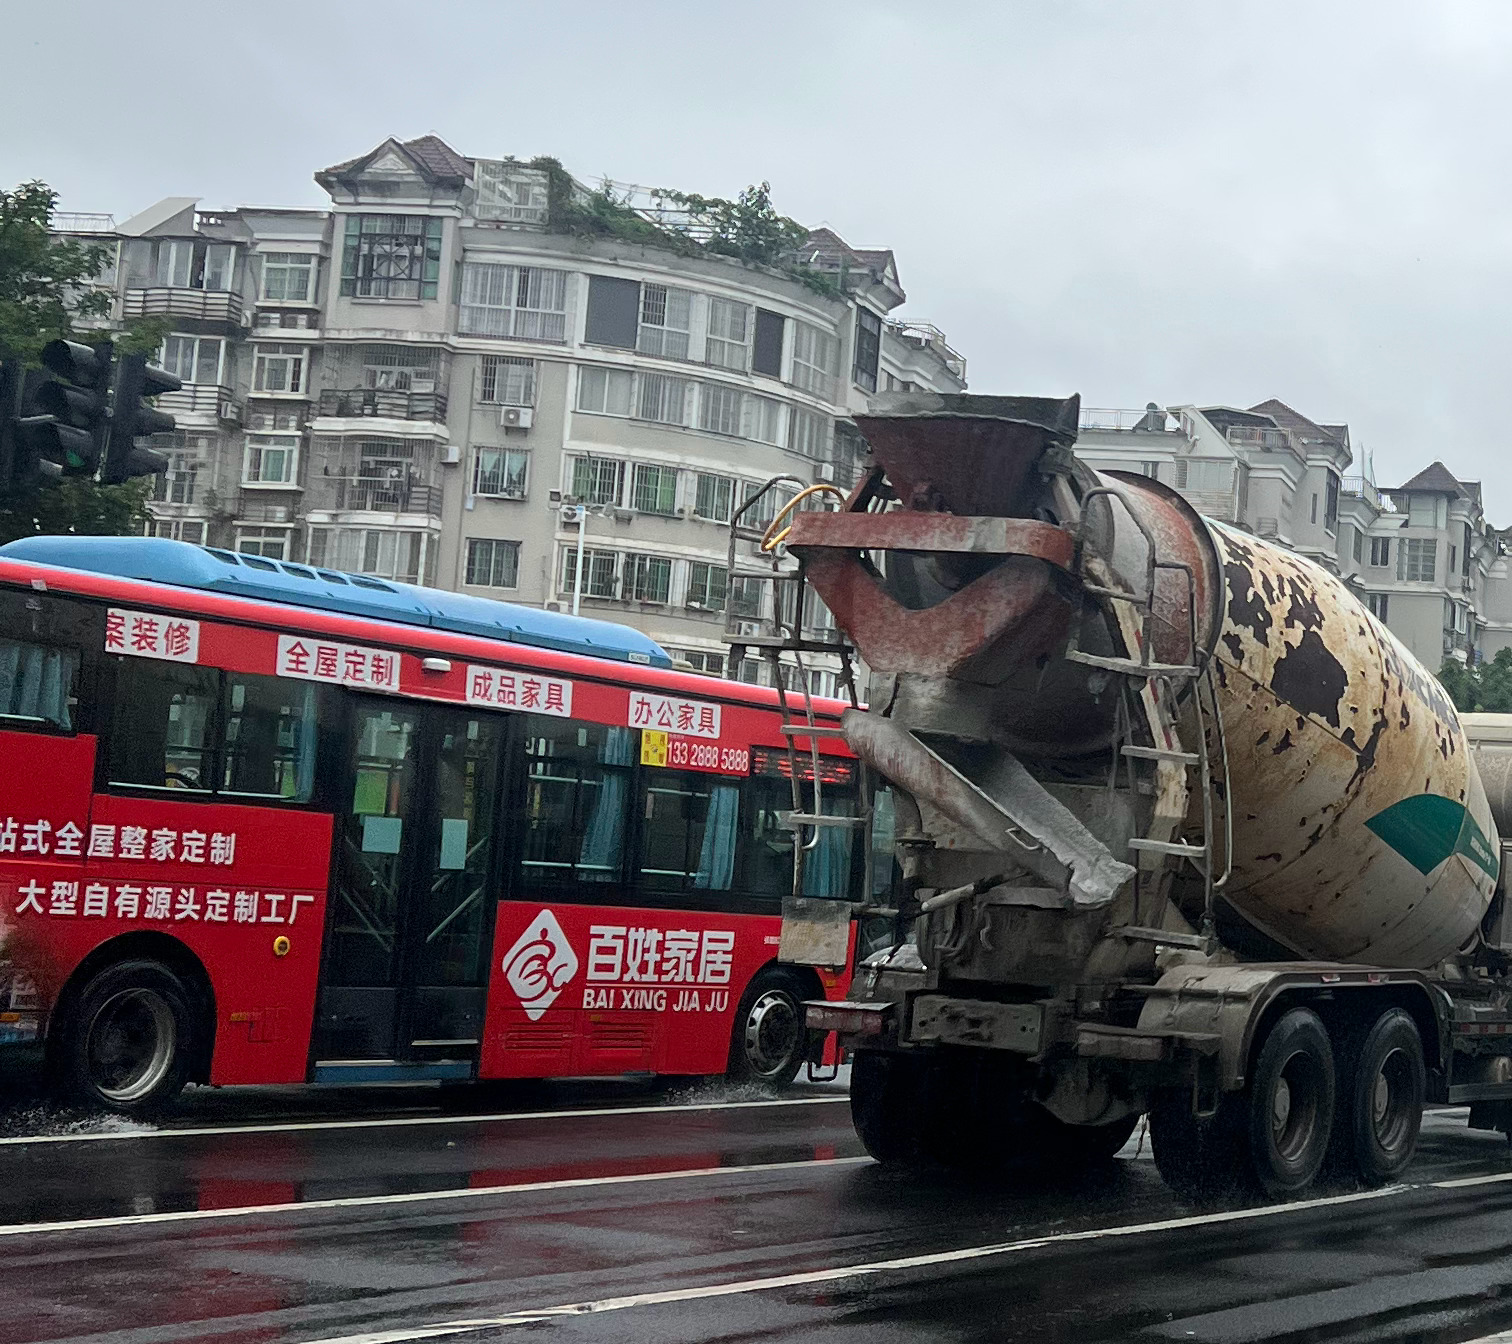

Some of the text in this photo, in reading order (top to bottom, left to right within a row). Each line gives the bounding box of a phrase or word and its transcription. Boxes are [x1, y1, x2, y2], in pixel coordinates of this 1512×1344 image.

[285, 641, 393, 686] 全屋定制
[472, 671, 565, 712] 成品家具
[634, 697, 715, 735] 办公家具
[667, 741, 688, 765] 133
[690, 744, 719, 768] 2888
[720, 748, 749, 772] 5888
[15, 878, 315, 925] 大型自有源头定制工厂
[586, 924, 736, 984] 百姓家居
[582, 988, 730, 1012] BAI XING JIA JU
